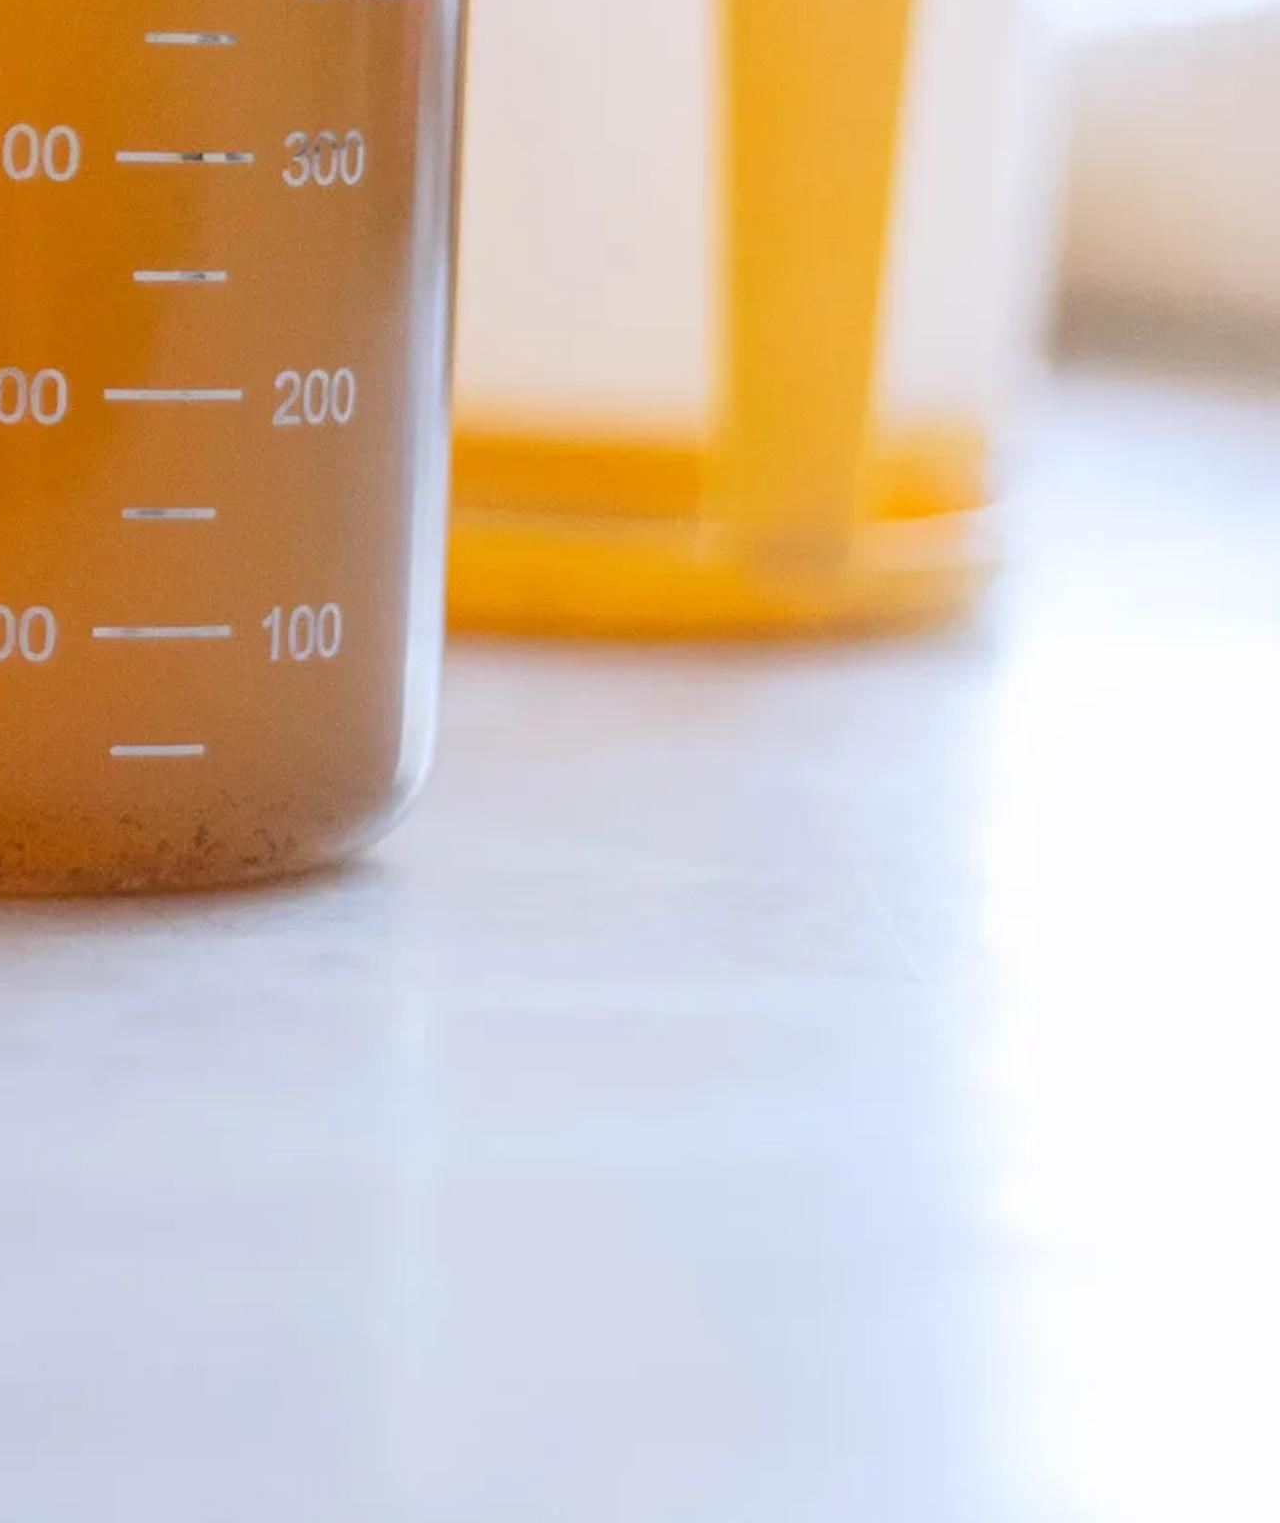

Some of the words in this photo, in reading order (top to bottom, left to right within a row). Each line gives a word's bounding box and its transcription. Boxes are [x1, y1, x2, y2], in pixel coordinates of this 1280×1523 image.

[281, 128, 366, 188] 300
[273, 367, 357, 427] 200
[262, 602, 343, 661] 100
